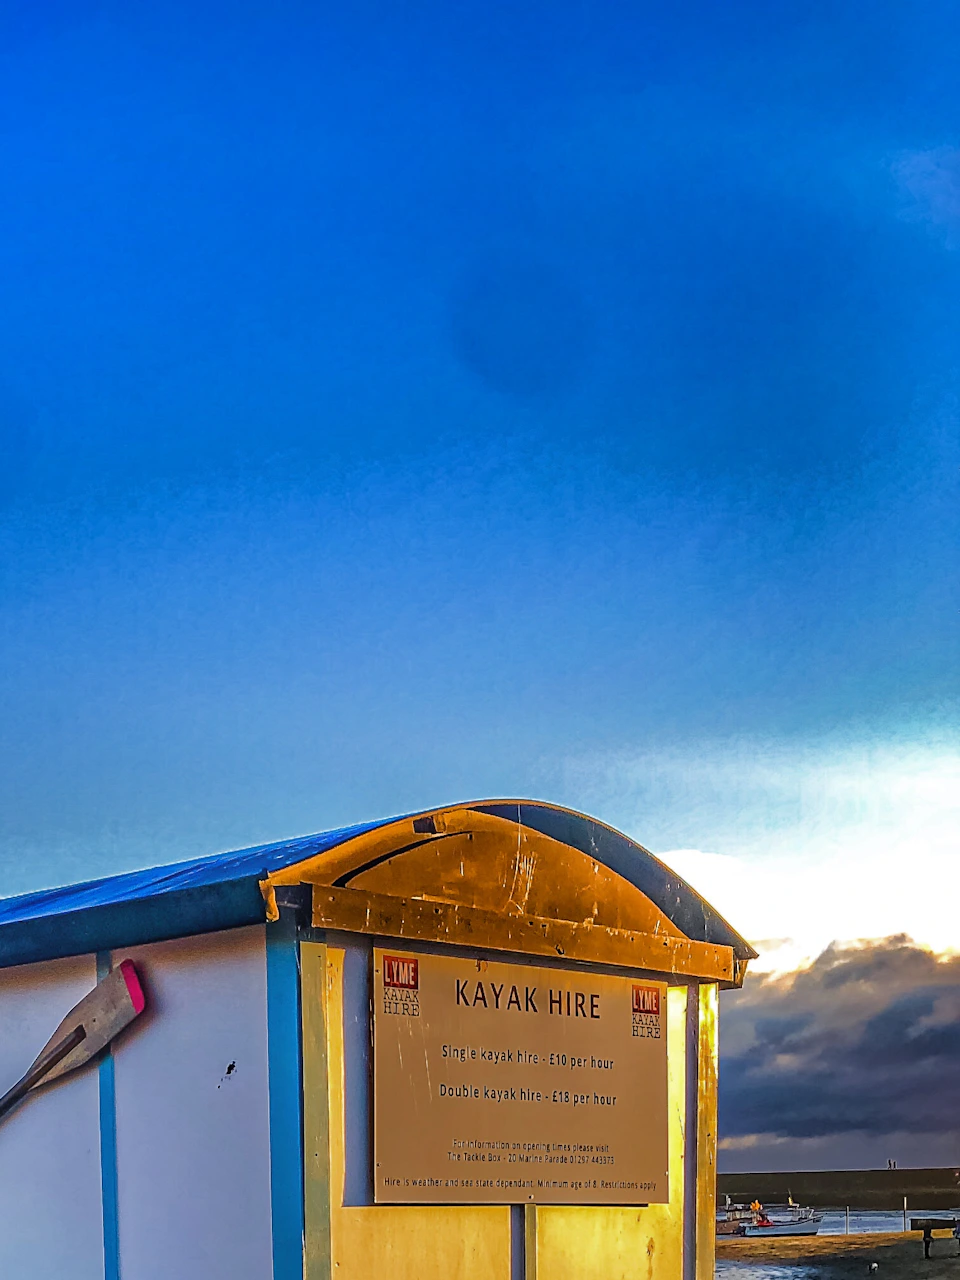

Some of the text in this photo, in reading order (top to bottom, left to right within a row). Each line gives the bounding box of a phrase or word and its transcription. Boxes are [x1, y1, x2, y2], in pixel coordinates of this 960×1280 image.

[385, 960, 415, 985] LYME
[383, 988, 419, 1003] KAYAK
[456, 979, 600, 1019] KAYAK HIRE
[633, 989, 657, 1011] LYME
[383, 1001, 420, 1017] HIRE
[632, 1013, 660, 1026] KAYAK
[632, 1025, 660, 1039] HIRE
[442, 1045, 477, 1062] Single
[480, 1047, 513, 1064] kayak
[517, 1050, 539, 1064] hire
[549, 1053, 567, 1066] £10
[570, 1056, 587, 1070] per
[591, 1055, 614, 1070] hour
[440, 1084, 480, 1099] Double
[483, 1086, 517, 1102] kayak
[520, 1088, 542, 1102] hire
[552, 1091, 570, 1103] £18
[573, 1094, 590, 1107] per
[593, 1092, 617, 1106] hour
[453, 1139, 610, 1153] For information on opening times please visit
[447, 1151, 461, 1161] The
[464, 1152, 486, 1162] Tackle
[488, 1152, 501, 1163] Box
[508, 1153, 517, 1163] 20
[519, 1154, 543, 1164] Marine
[544, 1154, 568, 1165] Parade
[569, 1155, 590, 1165] 01297
[384, 1177, 401, 1187] Hire
[403, 1178, 410, 1187] is
[412, 1178, 443, 1188] weather
[445, 1178, 459, 1188] and
[461, 1179, 474, 1188] sea
[476, 1178, 494, 1188] state
[537, 1179, 569, 1189] Minimum
[570, 1180, 582, 1191] age
[584, 1179, 592, 1189] of
[600, 1180, 638, 1190] Restrictions
[640, 1180, 657, 1192] apply
